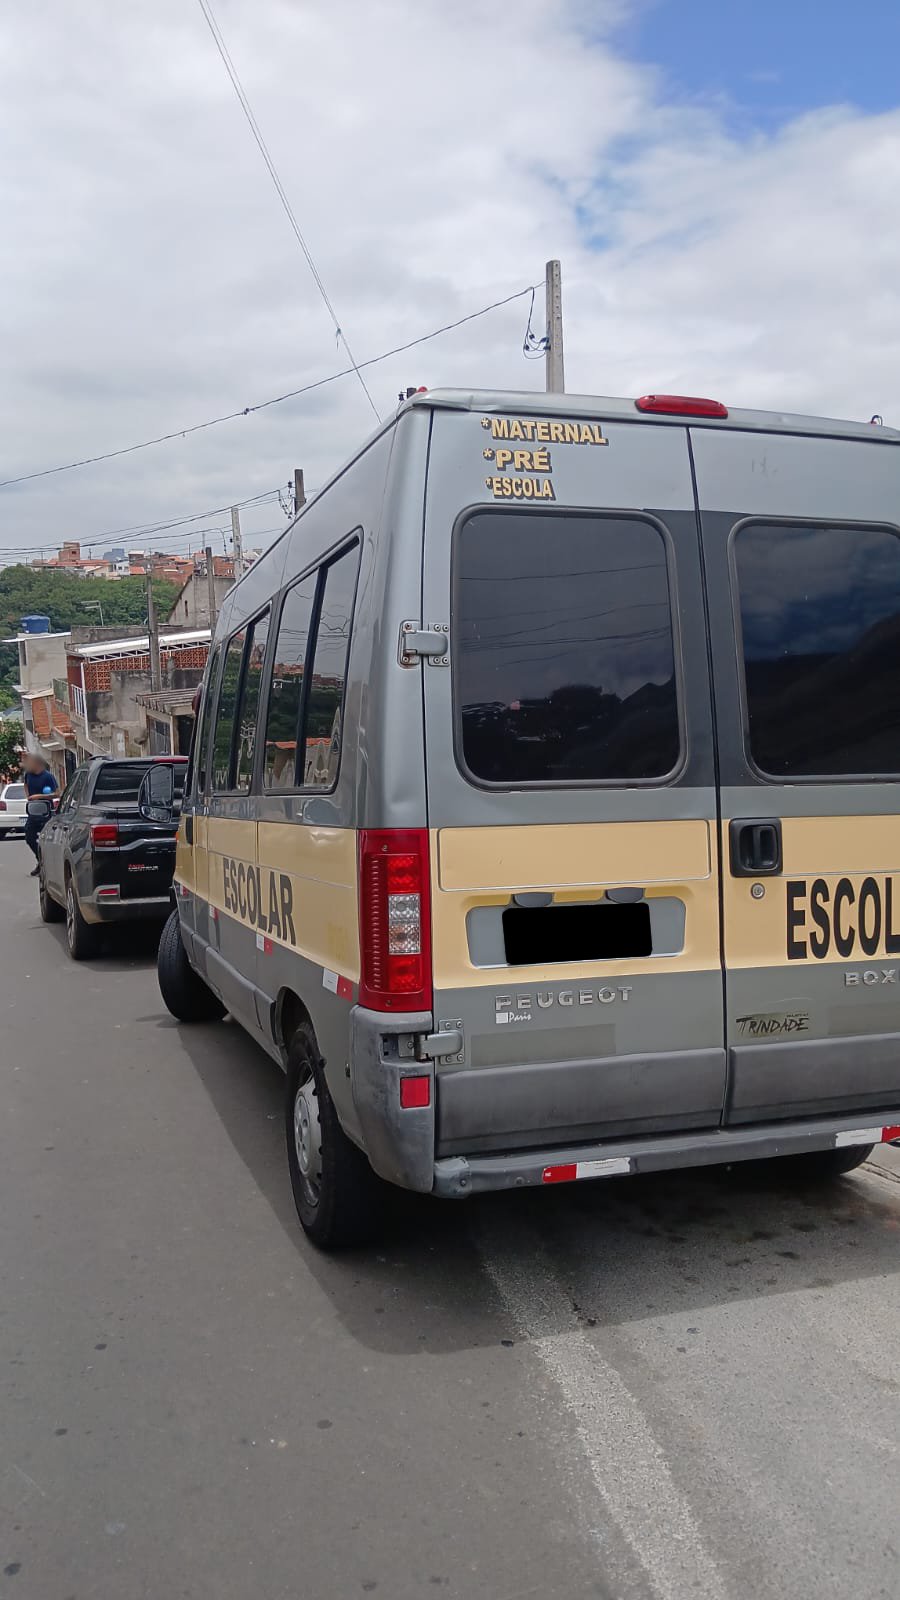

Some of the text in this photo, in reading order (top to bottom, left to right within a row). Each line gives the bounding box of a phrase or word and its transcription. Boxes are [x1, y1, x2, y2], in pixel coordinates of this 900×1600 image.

[223, 857, 296, 946] ESCOLAR
[495, 986, 633, 1011] PEUGEOT
[508, 1011, 532, 1023] Paris
